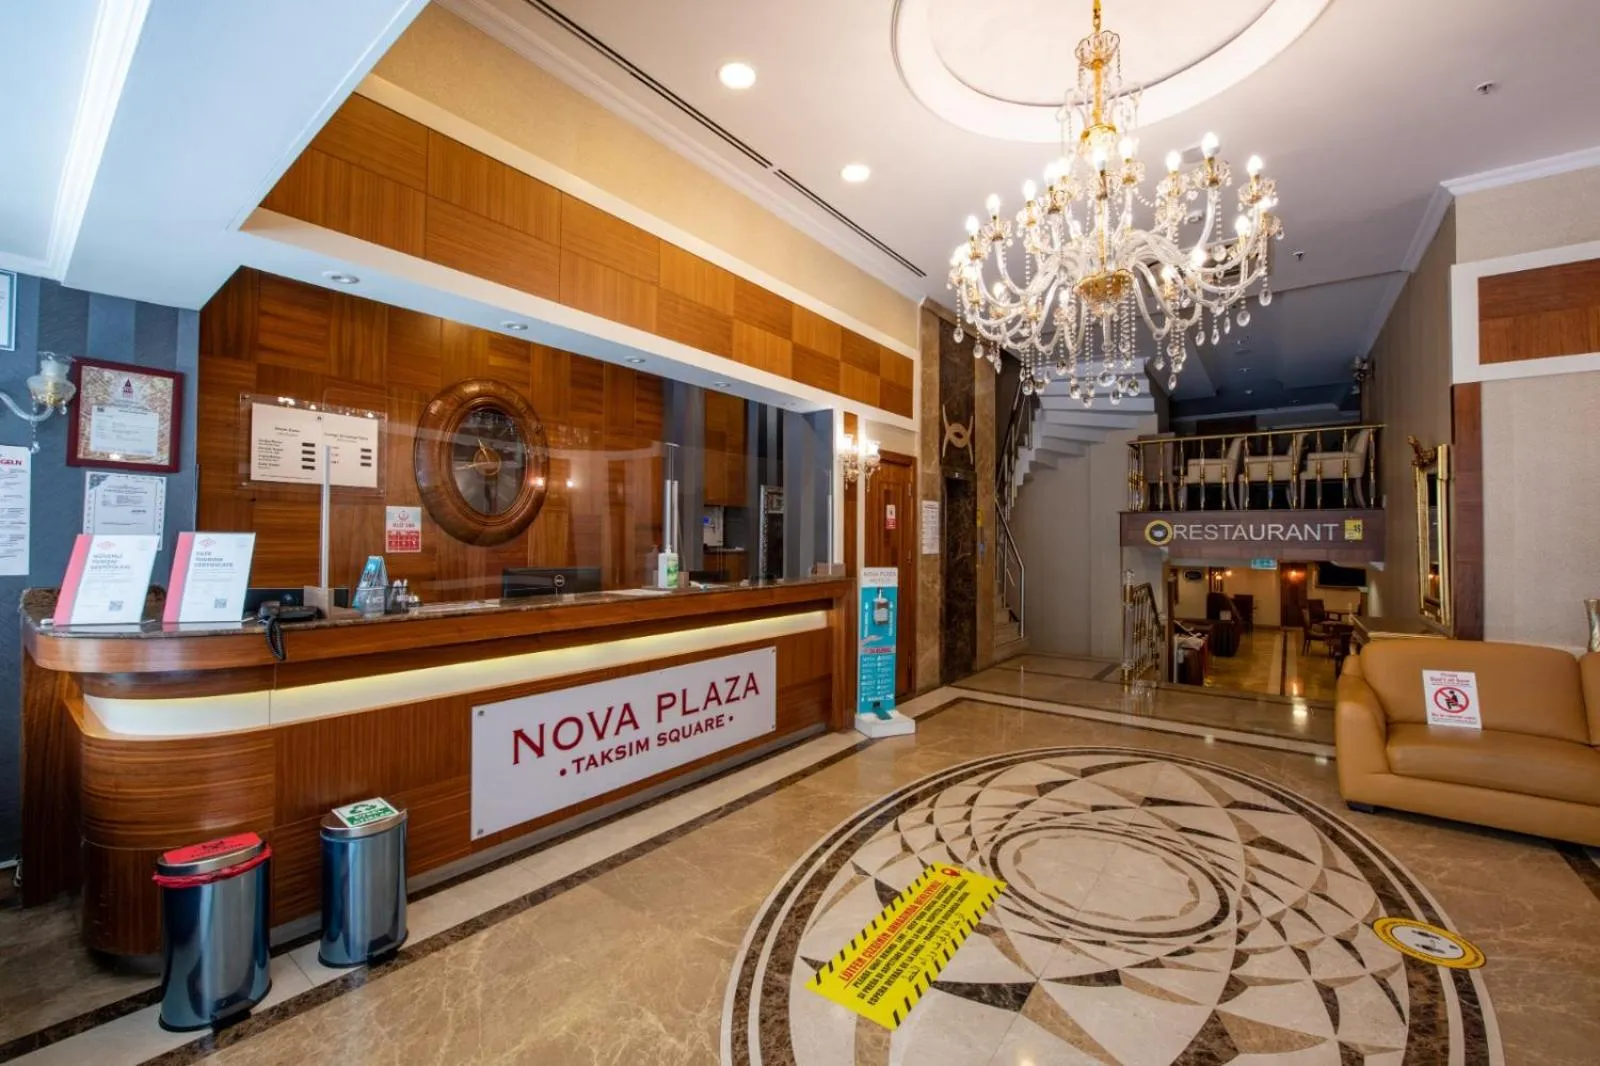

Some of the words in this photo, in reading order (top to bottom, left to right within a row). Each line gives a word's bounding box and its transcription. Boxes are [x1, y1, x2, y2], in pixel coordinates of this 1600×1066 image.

[1173, 523, 1339, 541] RESTAURANT
[511, 702, 640, 765] NOVA
[656, 672, 760, 723] PLAZA
[571, 737, 650, 774] TAKSIM
[656, 714, 726, 747] SQUARE
